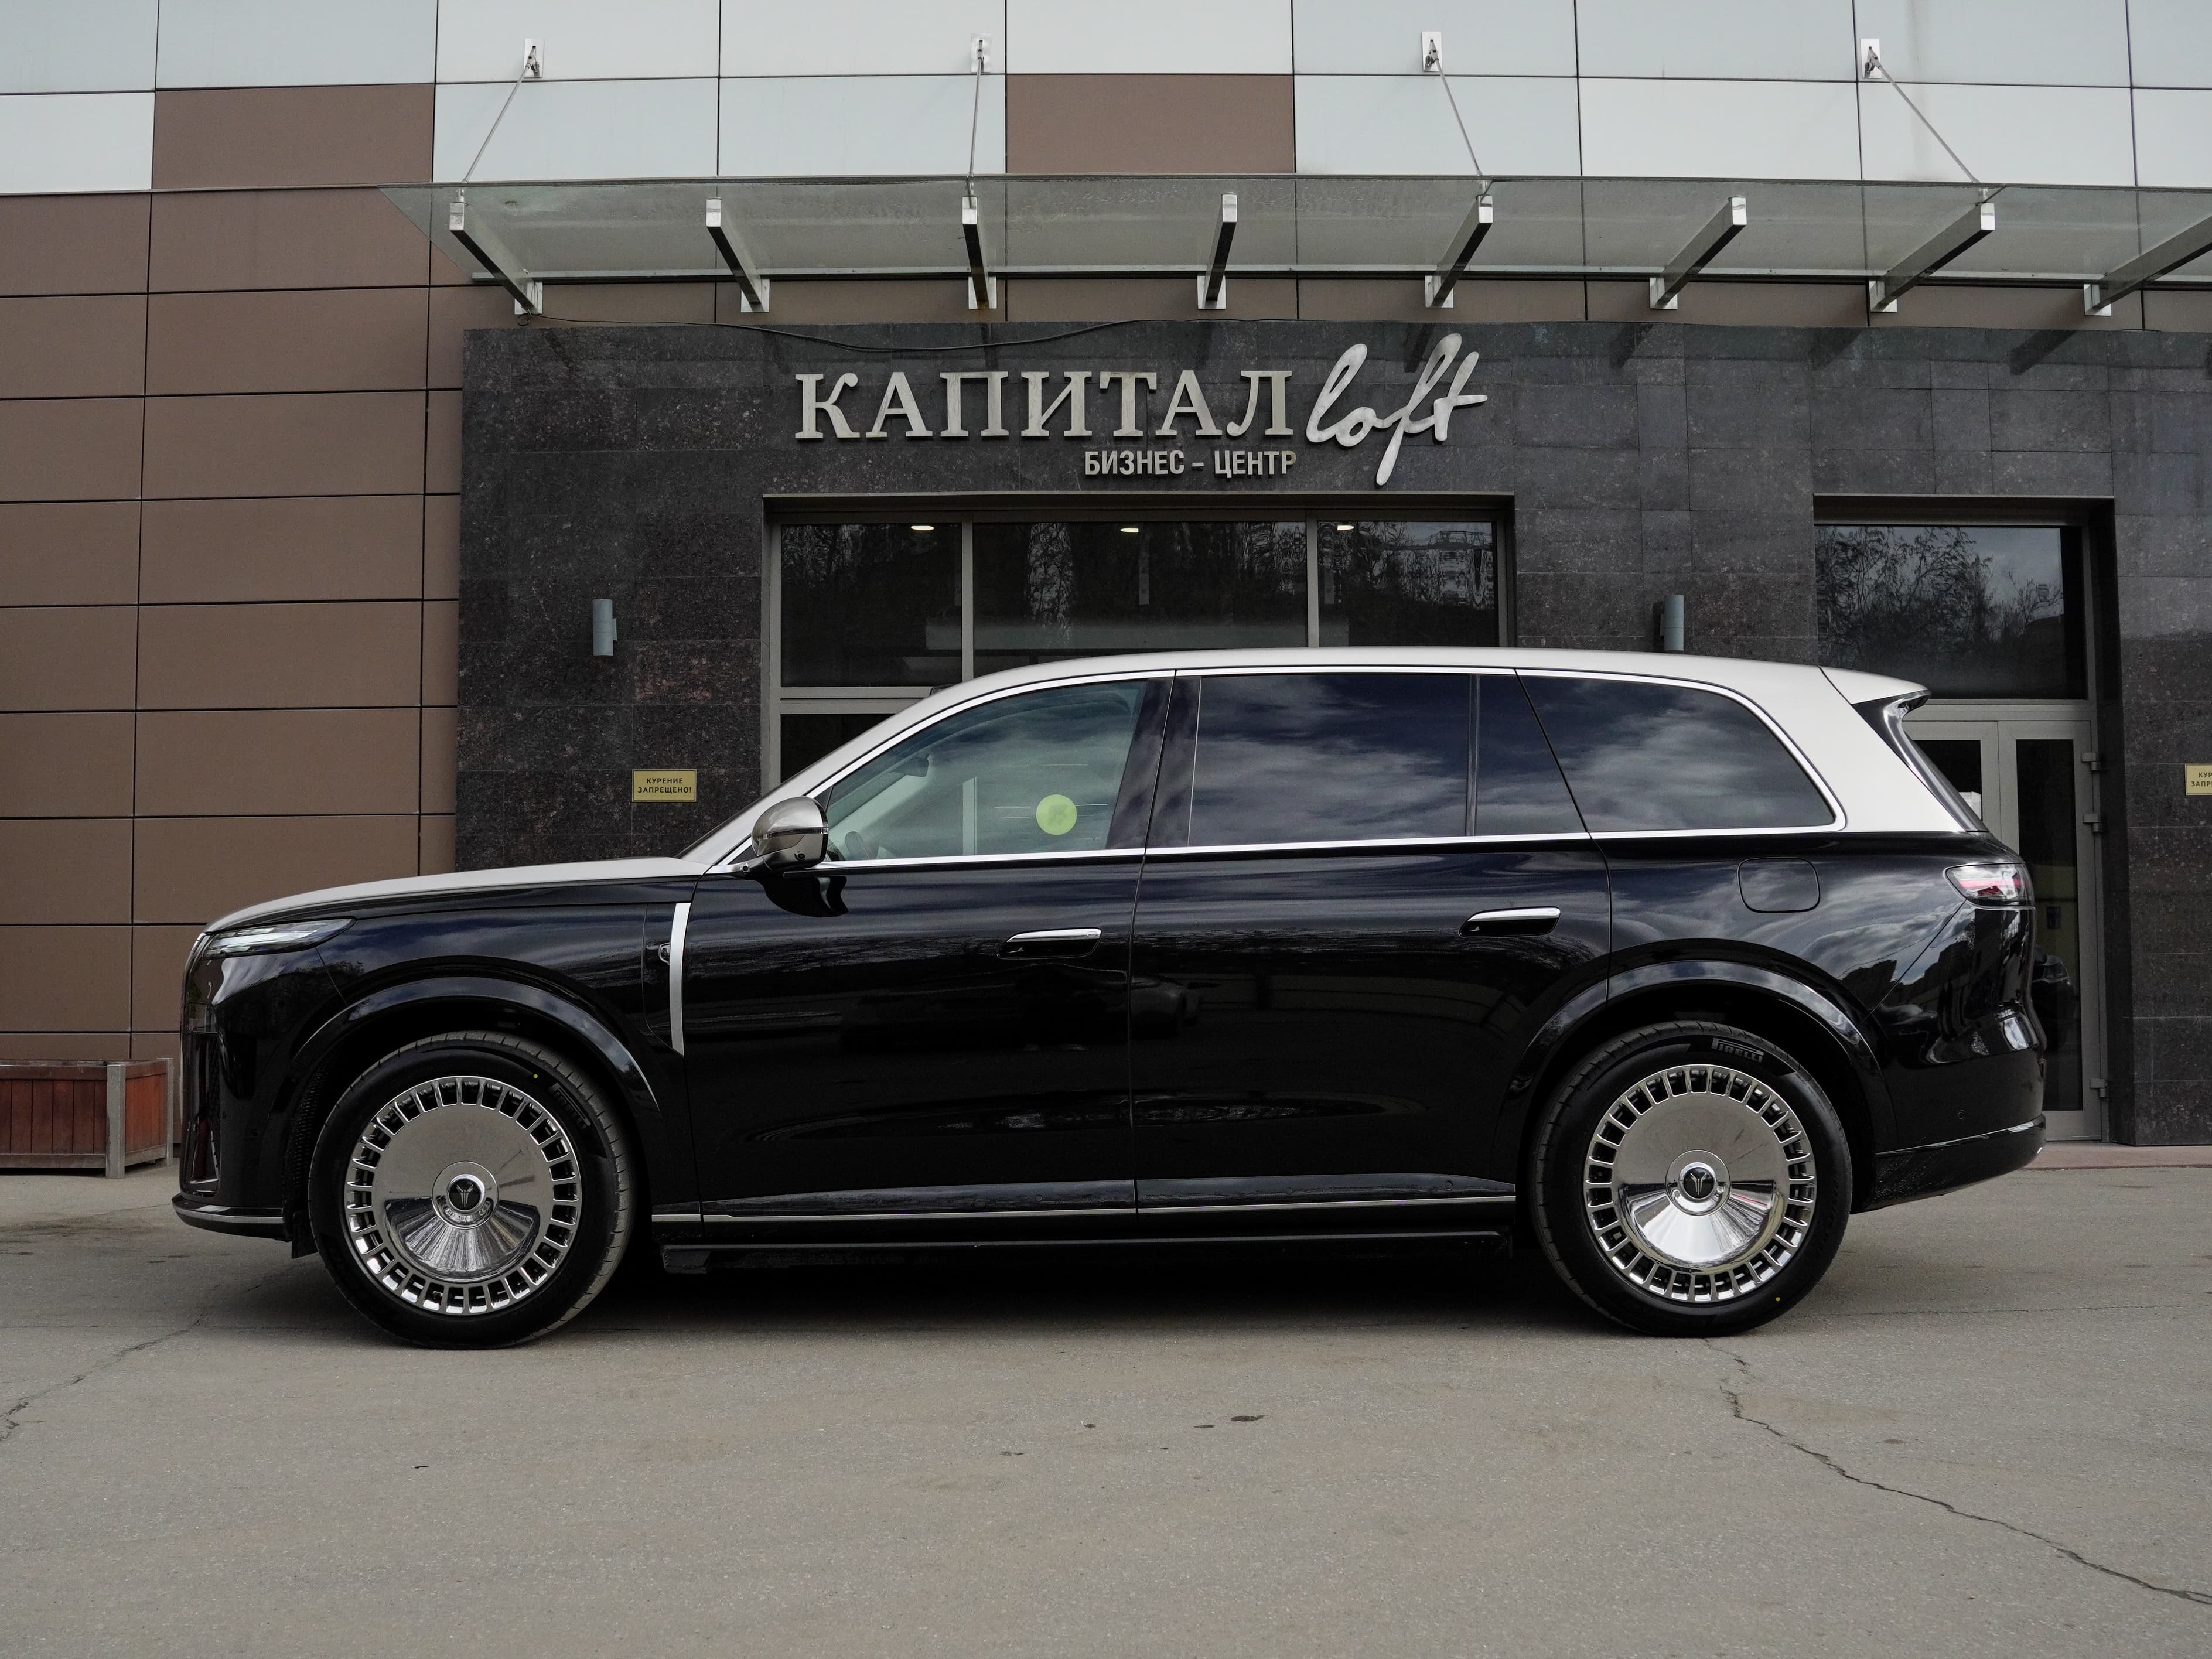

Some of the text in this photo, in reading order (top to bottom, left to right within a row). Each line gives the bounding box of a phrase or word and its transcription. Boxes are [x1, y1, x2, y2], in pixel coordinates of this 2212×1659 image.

[795, 371, 1293, 439] КАПИТАЛ
[1306, 333, 1487, 486] loft
[1085, 450, 1185, 475] БИЗНЕС
[1214, 450, 1297, 479] ЦЕНТР
[1711, 1037, 1764, 1063] PIRELLI
